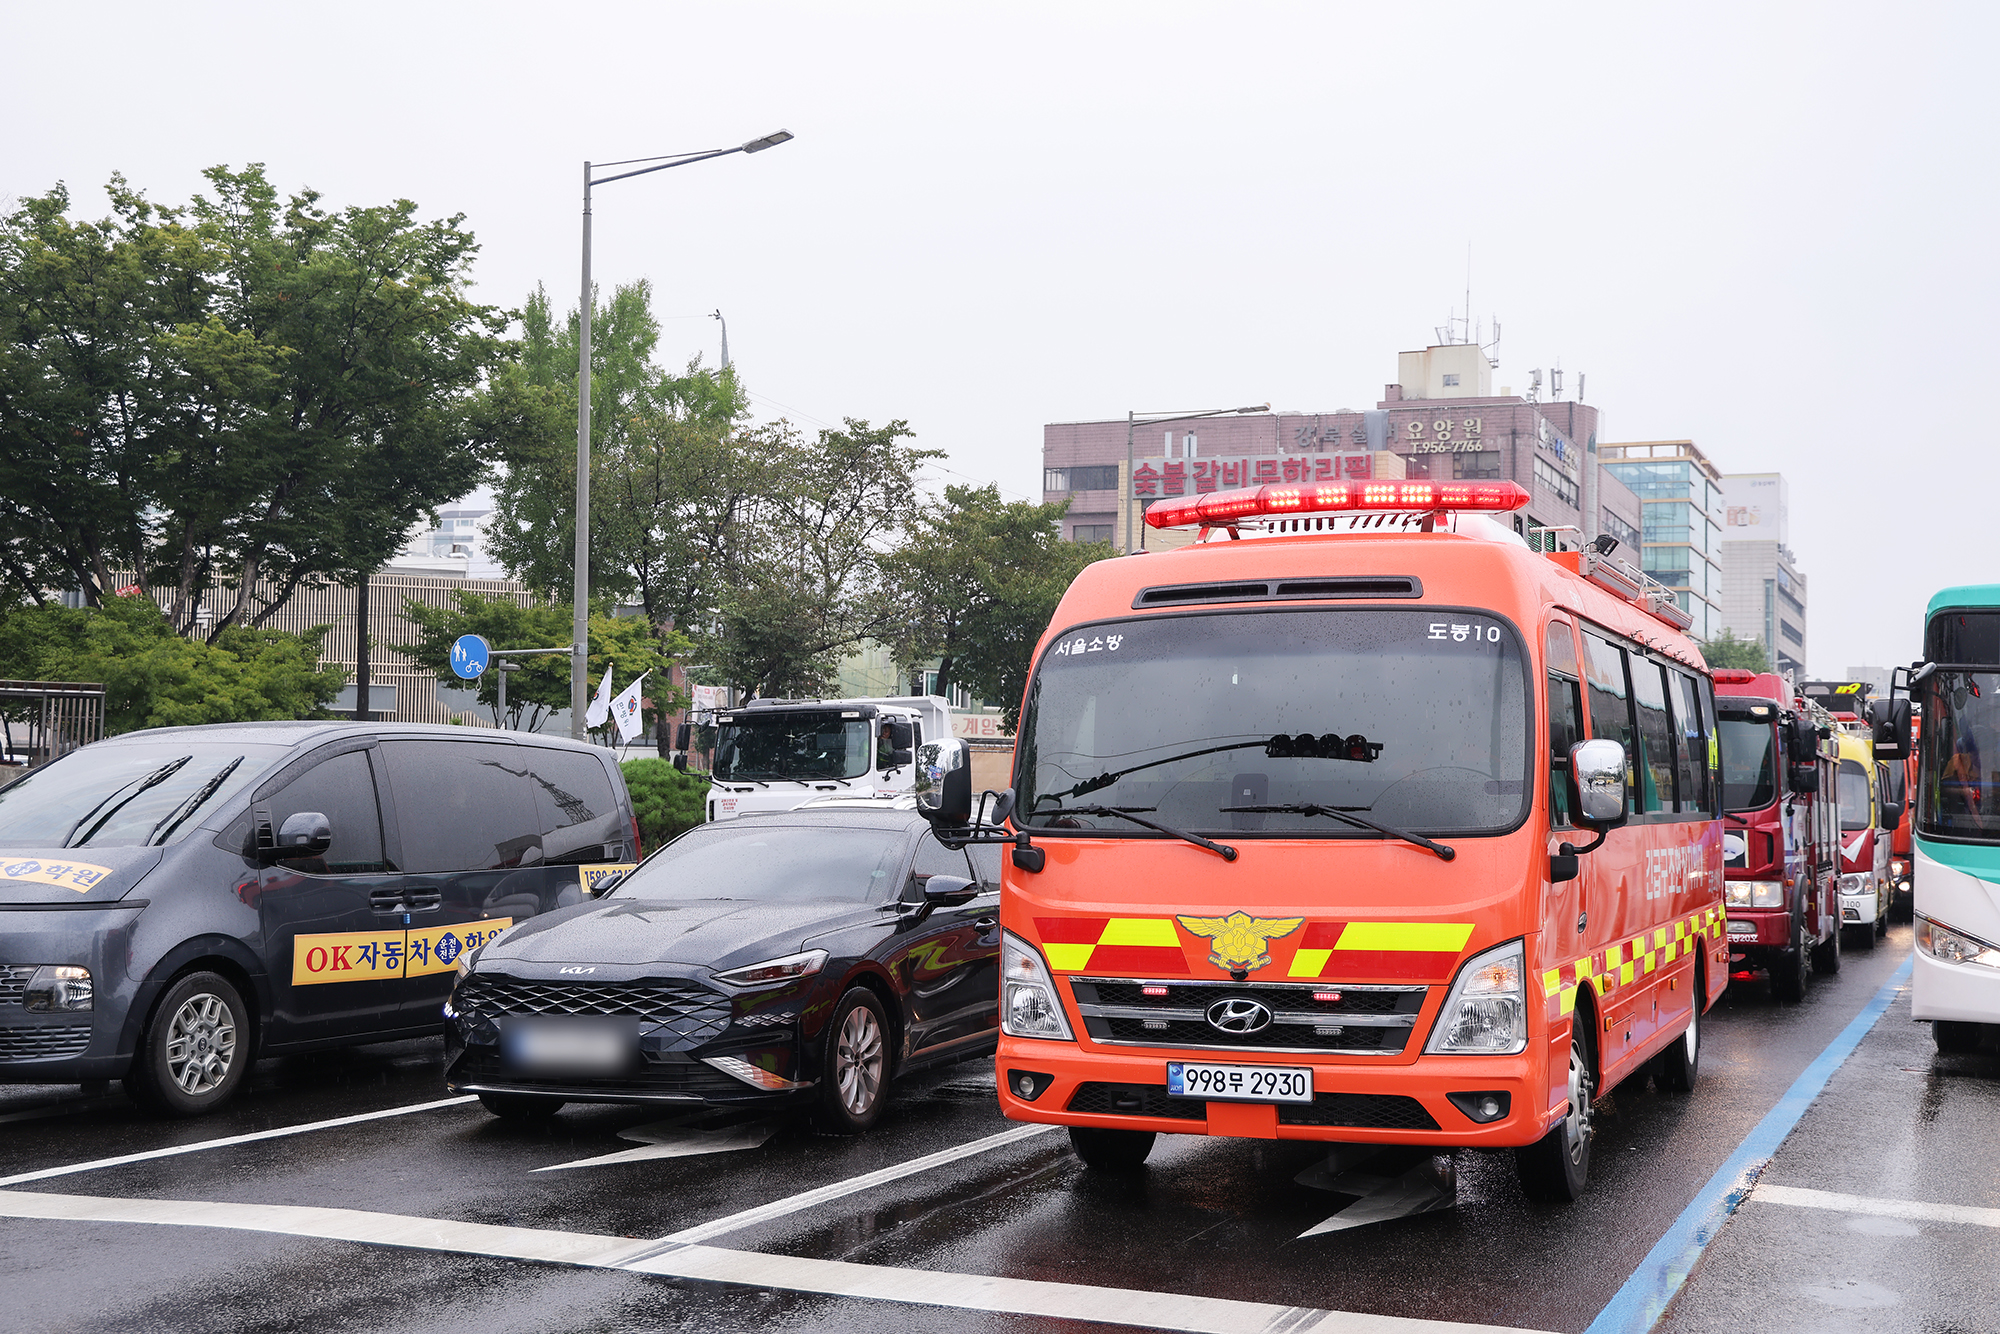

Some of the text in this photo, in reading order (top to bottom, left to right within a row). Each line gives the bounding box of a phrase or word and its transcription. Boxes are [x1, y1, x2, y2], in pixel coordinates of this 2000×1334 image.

[1404, 418, 1482, 440] 요양원
[1410, 440, 1483, 454] T.956-7766
[1427, 623, 1501, 643] 도봉10
[1054, 634, 1124, 656] 서울소방
[45, 864, 103, 887] 학원
[1186, 1068, 1306, 1096] 998무 2930
